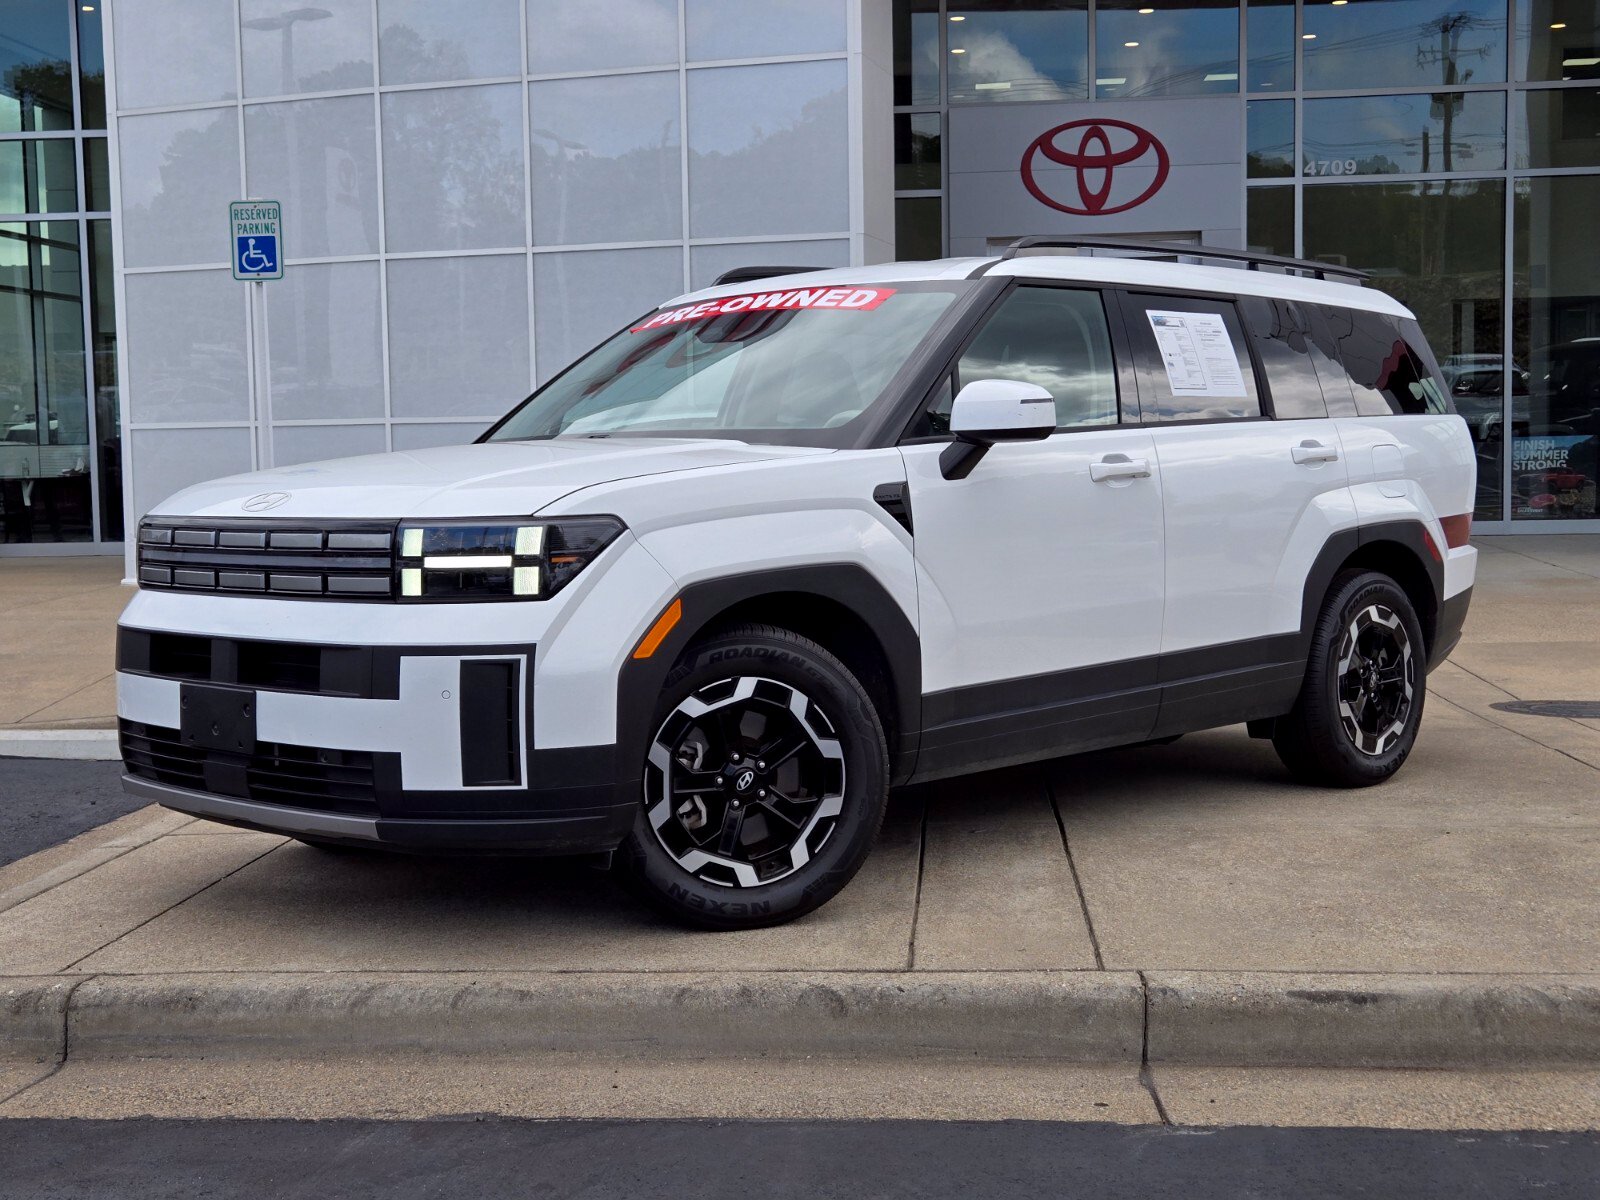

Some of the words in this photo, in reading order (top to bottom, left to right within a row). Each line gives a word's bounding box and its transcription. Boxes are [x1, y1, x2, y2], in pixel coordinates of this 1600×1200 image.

[1303, 159, 1357, 176] 4709
[233, 208, 278, 220] RESERVED
[237, 223, 276, 234] PARKING
[642, 289, 878, 328] PRE-OWNED
[1513, 439, 1555, 450] FINISH
[1513, 450, 1569, 460] SUMMER
[1512, 460, 1567, 471] STRONG
[709, 647, 806, 668] ROADIAN
[668, 882, 771, 916] NEXEN
